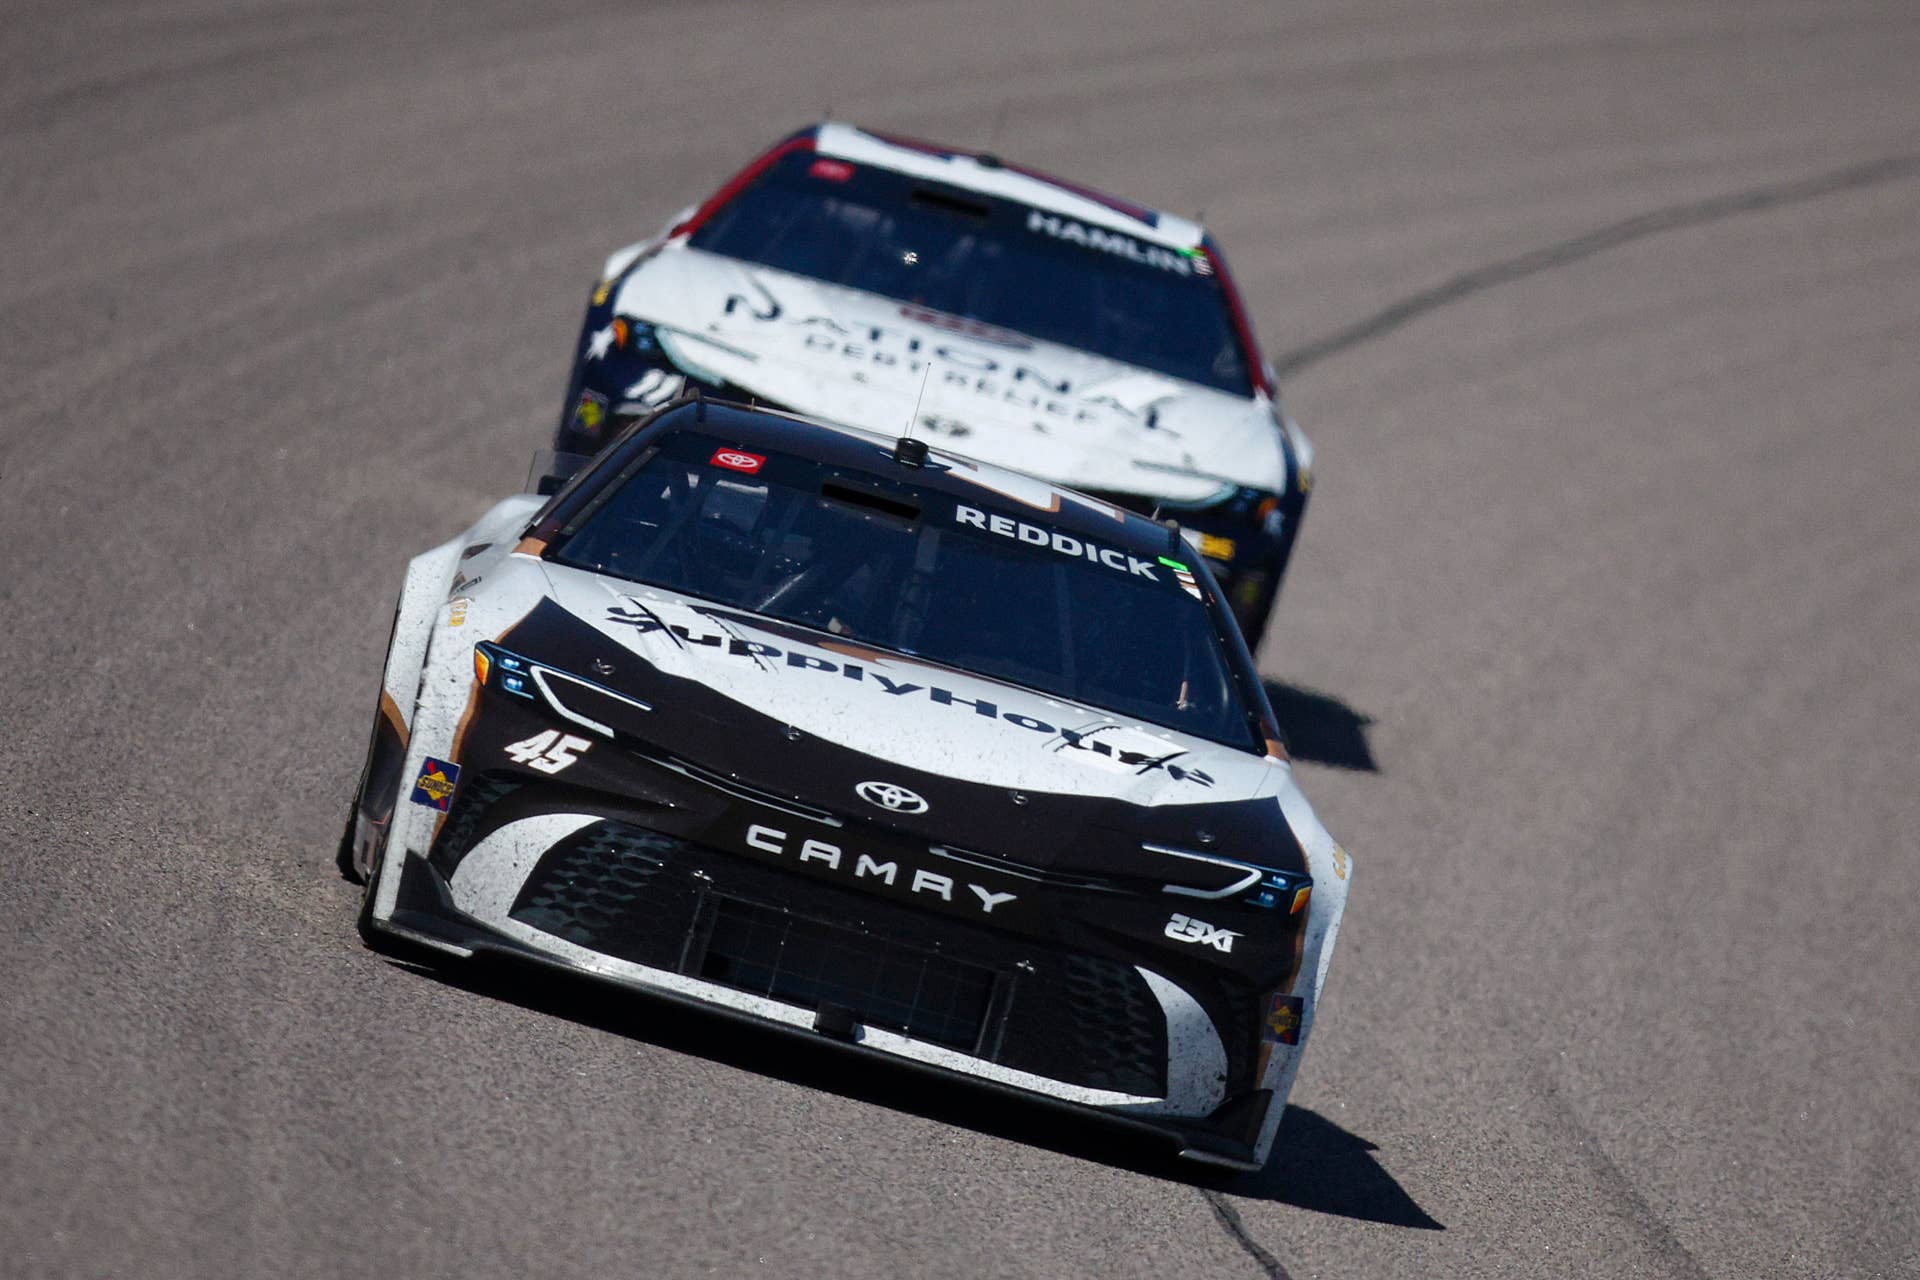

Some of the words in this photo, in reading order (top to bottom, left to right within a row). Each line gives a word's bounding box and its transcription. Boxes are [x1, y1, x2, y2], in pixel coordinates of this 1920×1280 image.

[1027, 210, 1192, 277] HAMLIN
[723, 268, 1182, 438] NATIONAL
[943, 368, 1099, 424] RELIEF
[956, 495, 1160, 582] REDDICK
[504, 729, 593, 775] 45
[746, 824, 1018, 913] CAMRY
